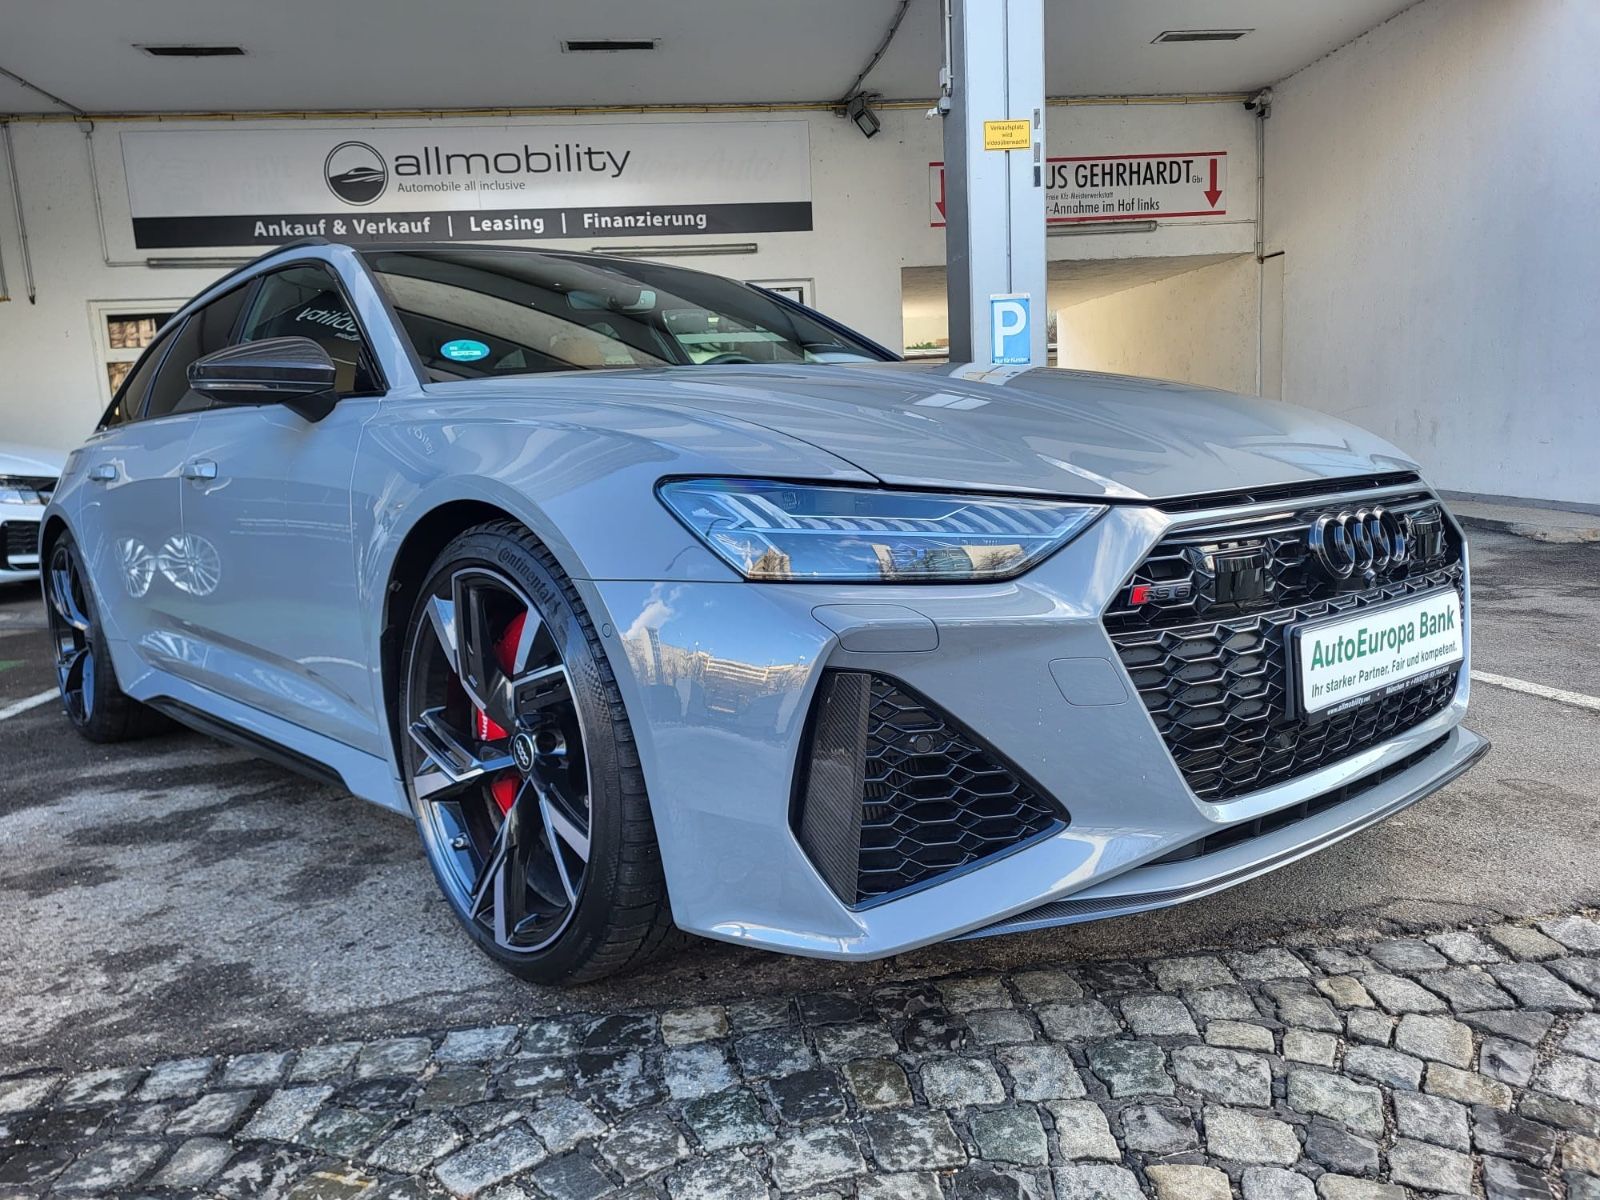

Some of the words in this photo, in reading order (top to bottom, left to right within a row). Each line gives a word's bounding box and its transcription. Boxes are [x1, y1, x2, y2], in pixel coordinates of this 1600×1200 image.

[394, 143, 631, 178] allmobility
[1074, 159, 1194, 188] GEHRHARDT
[397, 181, 461, 193] Automobile
[464, 181, 476, 192] all
[479, 180, 526, 191] inclusive
[1102, 200, 1115, 213] im
[1118, 197, 1135, 212] Hof
[1137, 197, 1160, 211] links
[254, 219, 326, 237] Ankauf
[332, 219, 347, 235] &
[352, 216, 431, 235] Verkauf
[469, 214, 545, 233] Leasing
[583, 211, 707, 229] Finanzierung
[994, 302, 1026, 357] P
[497, 547, 556, 607] Continental
[1310, 621, 1415, 671] AutoEuropa
[1419, 604, 1455, 638] Bank
[1311, 683, 1323, 698] Ihr
[1326, 673, 1357, 693] starker
[1359, 665, 1390, 683] Partner.
[1391, 658, 1405, 673] Fair
[1406, 652, 1420, 667] und
[1420, 640, 1458, 662] kompetent.
